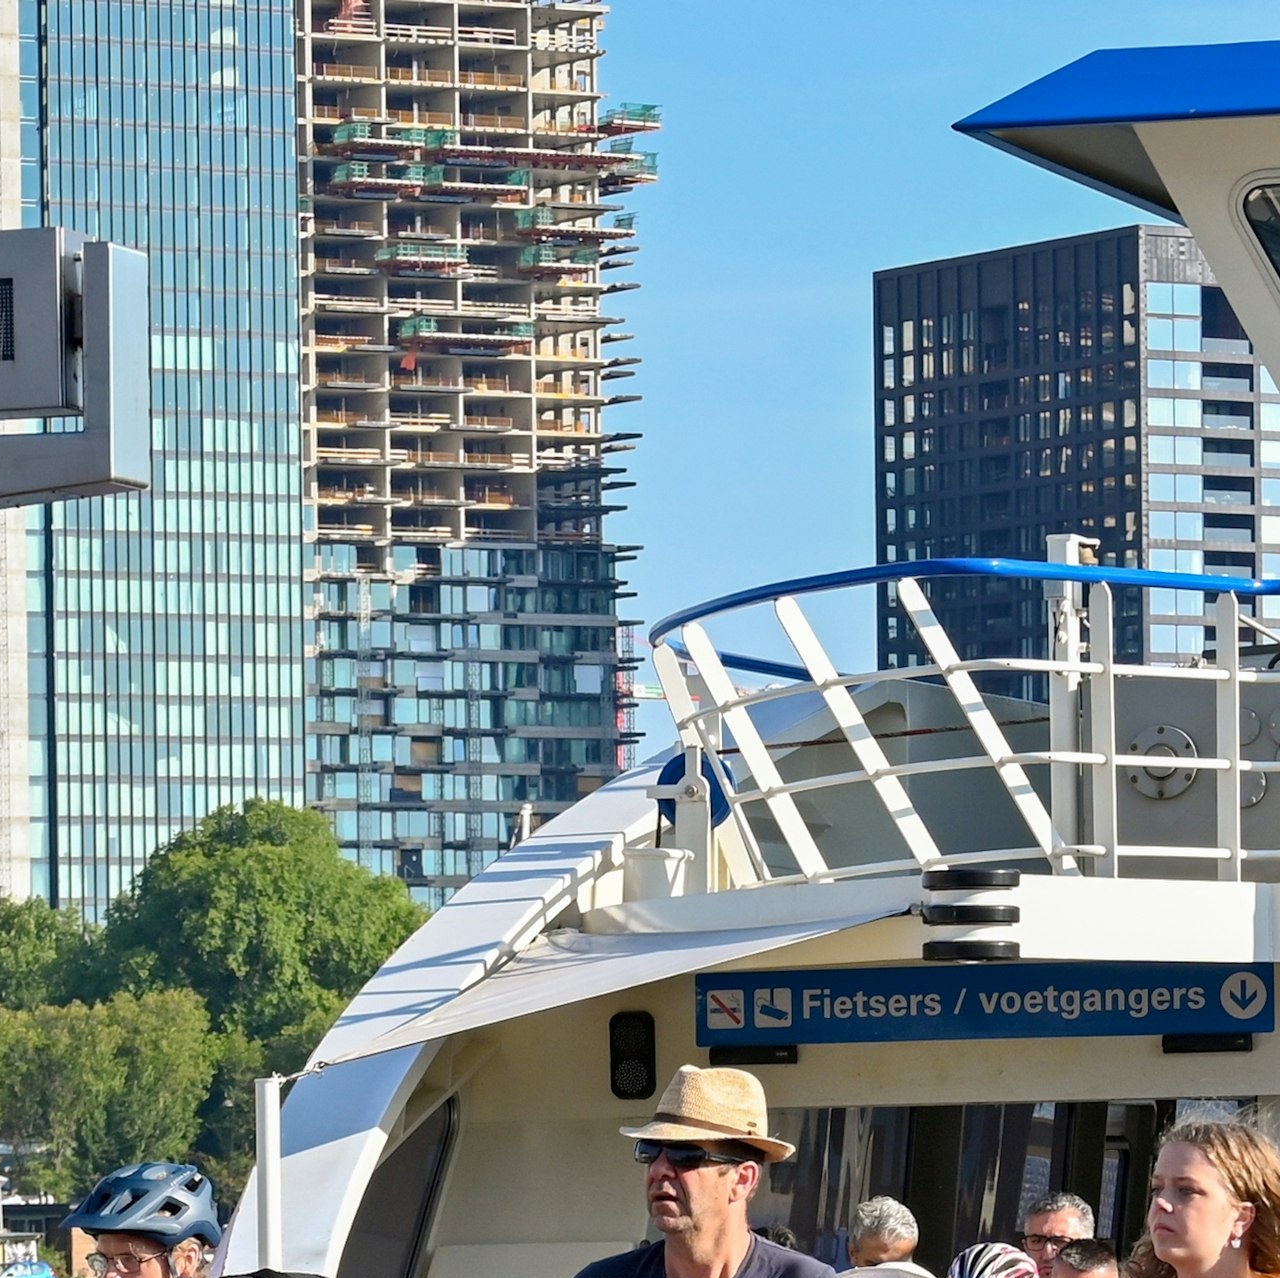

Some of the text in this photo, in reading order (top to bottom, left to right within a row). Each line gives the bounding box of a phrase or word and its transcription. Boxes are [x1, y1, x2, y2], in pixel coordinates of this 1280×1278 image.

[801, 984, 1207, 1020] Fietsers / voetgangers
